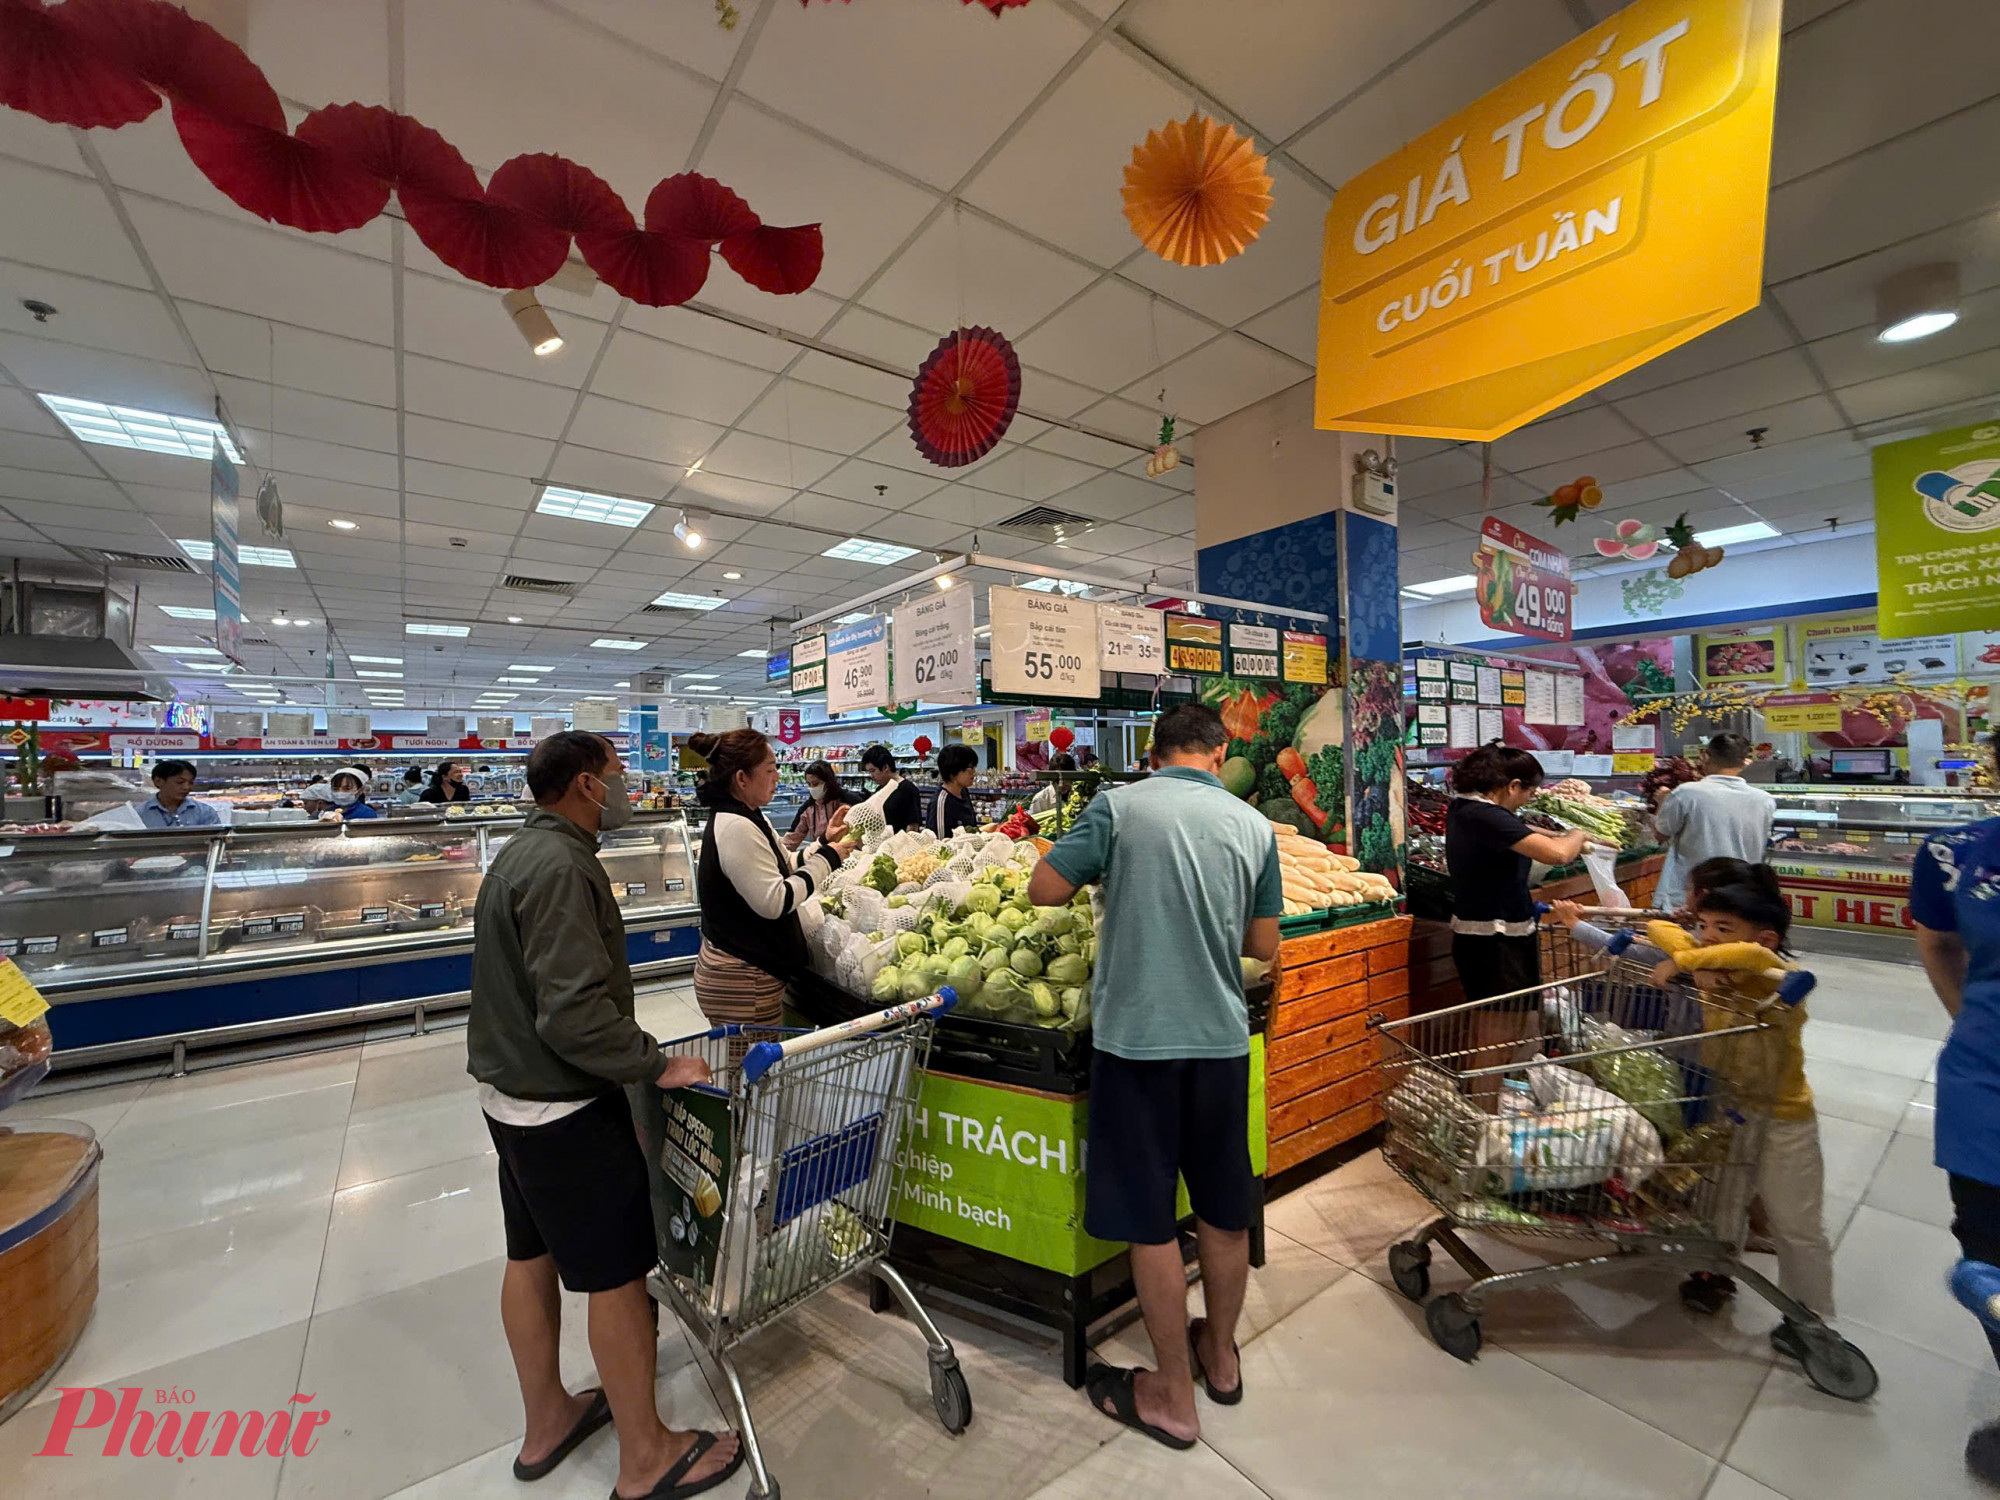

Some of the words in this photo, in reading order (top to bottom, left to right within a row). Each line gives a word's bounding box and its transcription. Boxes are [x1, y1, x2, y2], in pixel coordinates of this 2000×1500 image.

[1353, 135, 1471, 255] GIÁ
[1492, 19, 1691, 182] TỐT
[1376, 258, 1472, 333] CUỐI
[1483, 197, 1622, 285] TUẦN
[1919, 560, 1970, 577] TICK
[1977, 556, 2000, 571] XA
[1904, 573, 1979, 596] TRÁCH
[1028, 599, 1052, 613] BẢNG
[1053, 602, 1068, 614] GIÁ
[1546, 613, 1564, 637] đồng
[904, 1180, 952, 1213] Minh
[957, 1196, 1011, 1232] bạch
